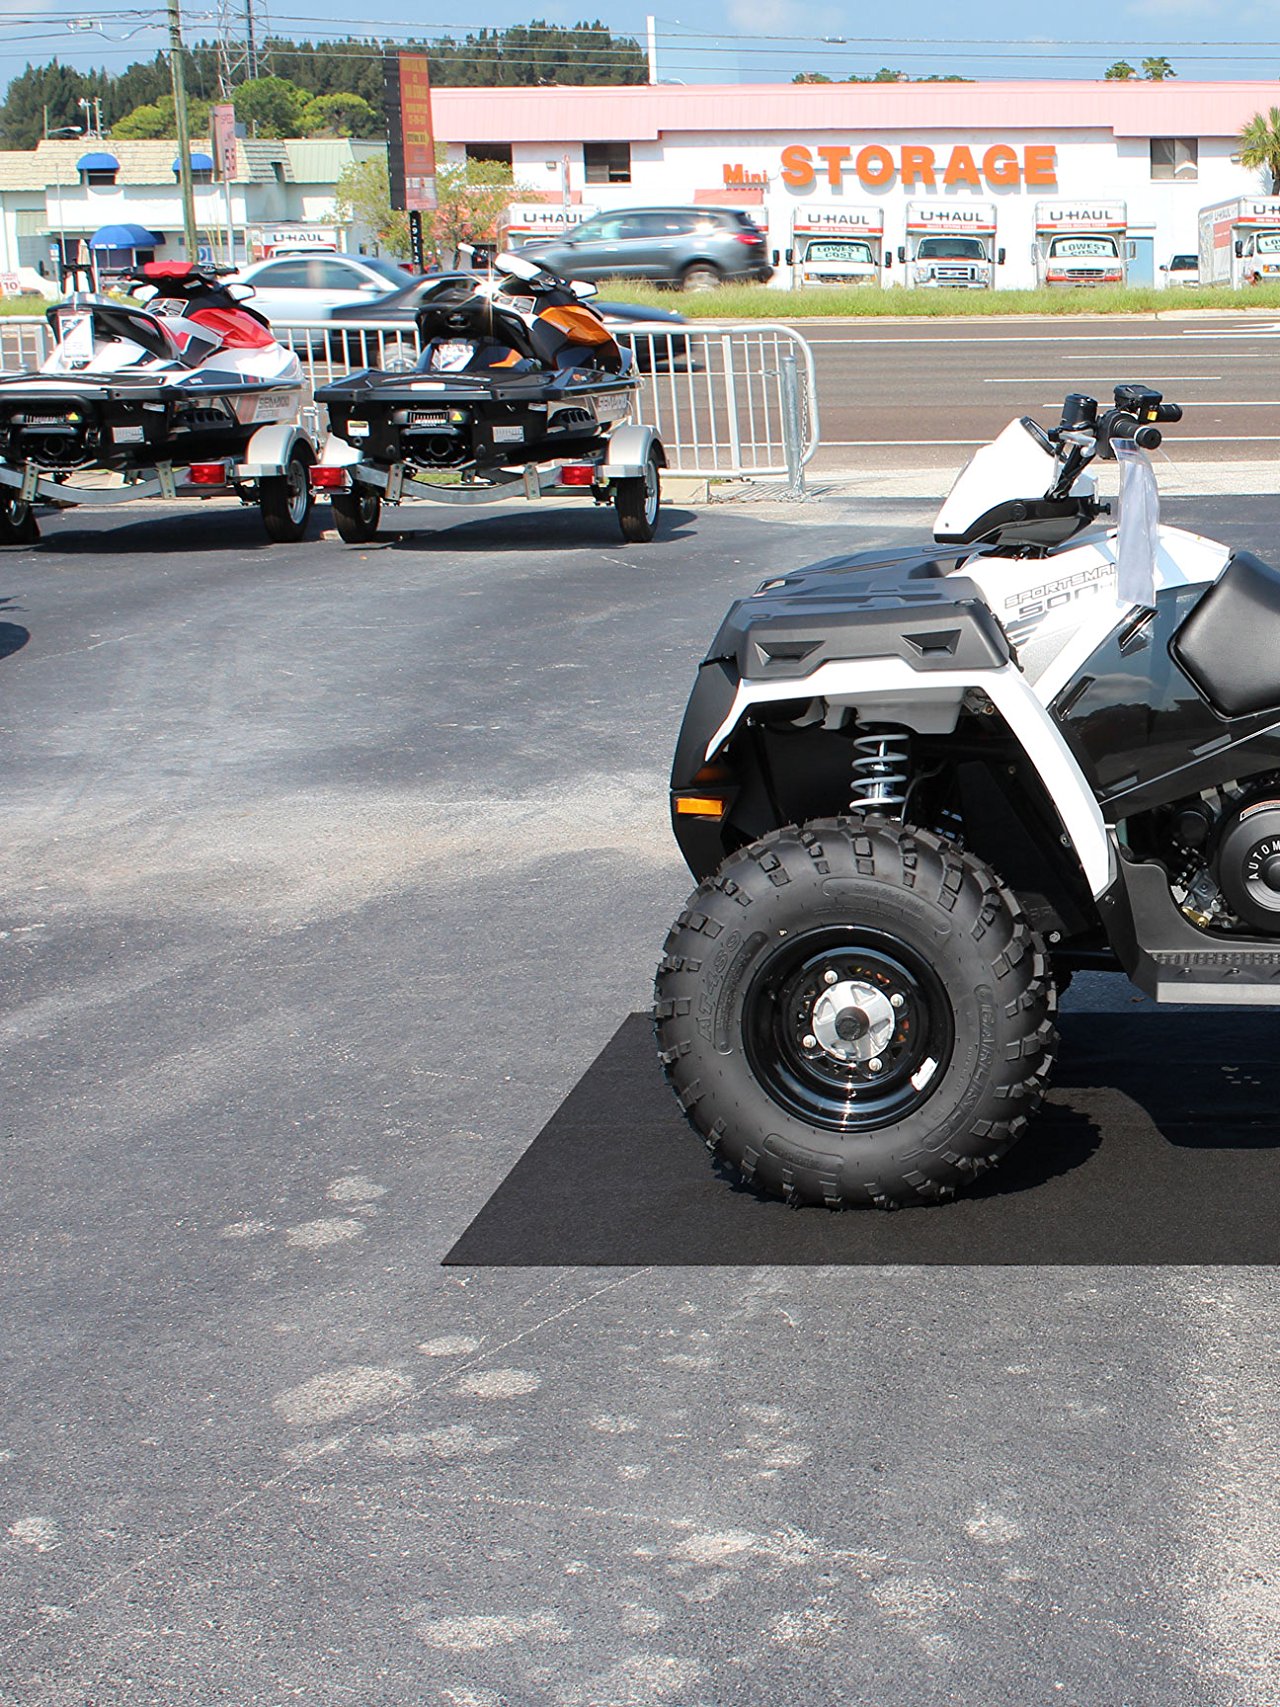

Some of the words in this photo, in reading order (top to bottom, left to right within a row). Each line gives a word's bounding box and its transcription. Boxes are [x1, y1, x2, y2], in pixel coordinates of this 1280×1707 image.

[723, 164, 768, 184] Mini
[780, 144, 1057, 186] STORAGE
[807, 213, 870, 225] U-HAUL
[920, 210, 984, 223] U-HAUL
[1050, 210, 1113, 221] U-HAUL
[273, 233, 325, 242] U-HAUL
[816, 244, 861, 254] LOWEST
[1062, 243, 1107, 252] LOWEST
[825, 251, 853, 259] COST
[1019, 583, 1098, 619] 500
